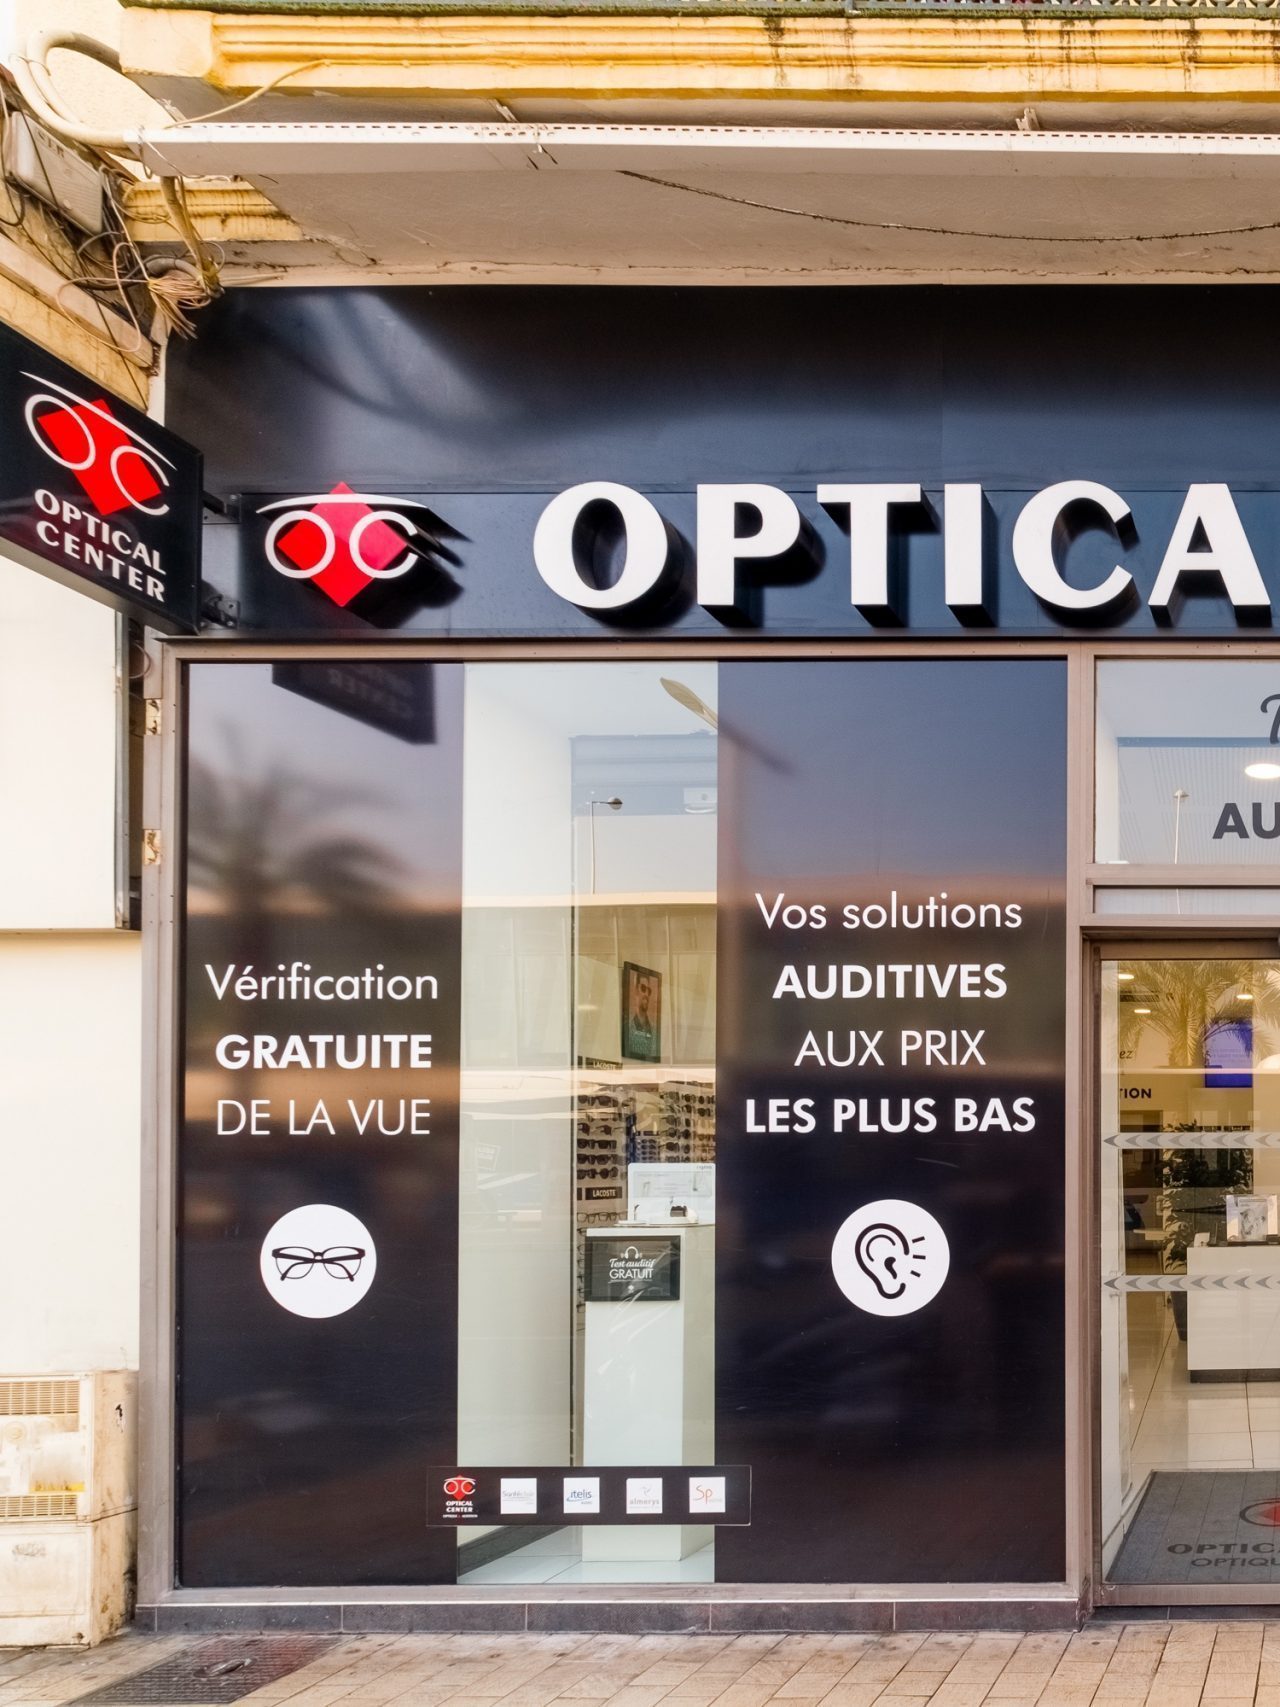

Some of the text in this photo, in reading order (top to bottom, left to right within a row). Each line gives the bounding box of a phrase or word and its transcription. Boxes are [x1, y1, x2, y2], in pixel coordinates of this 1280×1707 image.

[35, 489, 167, 576] OPTICAL
[36, 520, 165, 603] CENTER
[755, 890, 1022, 929] Vos solutions
[205, 961, 437, 1000] Vérification
[772, 963, 1007, 999] AUDITIVES
[216, 1034, 432, 1069] GRATUITE
[794, 1030, 986, 1067] AUX PRIX
[217, 1099, 430, 1136] DE LA VUE
[746, 1096, 1036, 1134] LES PLUS BAS
[609, 1258, 625, 1268] Test
[609, 1268, 654, 1279] GRATUIT
